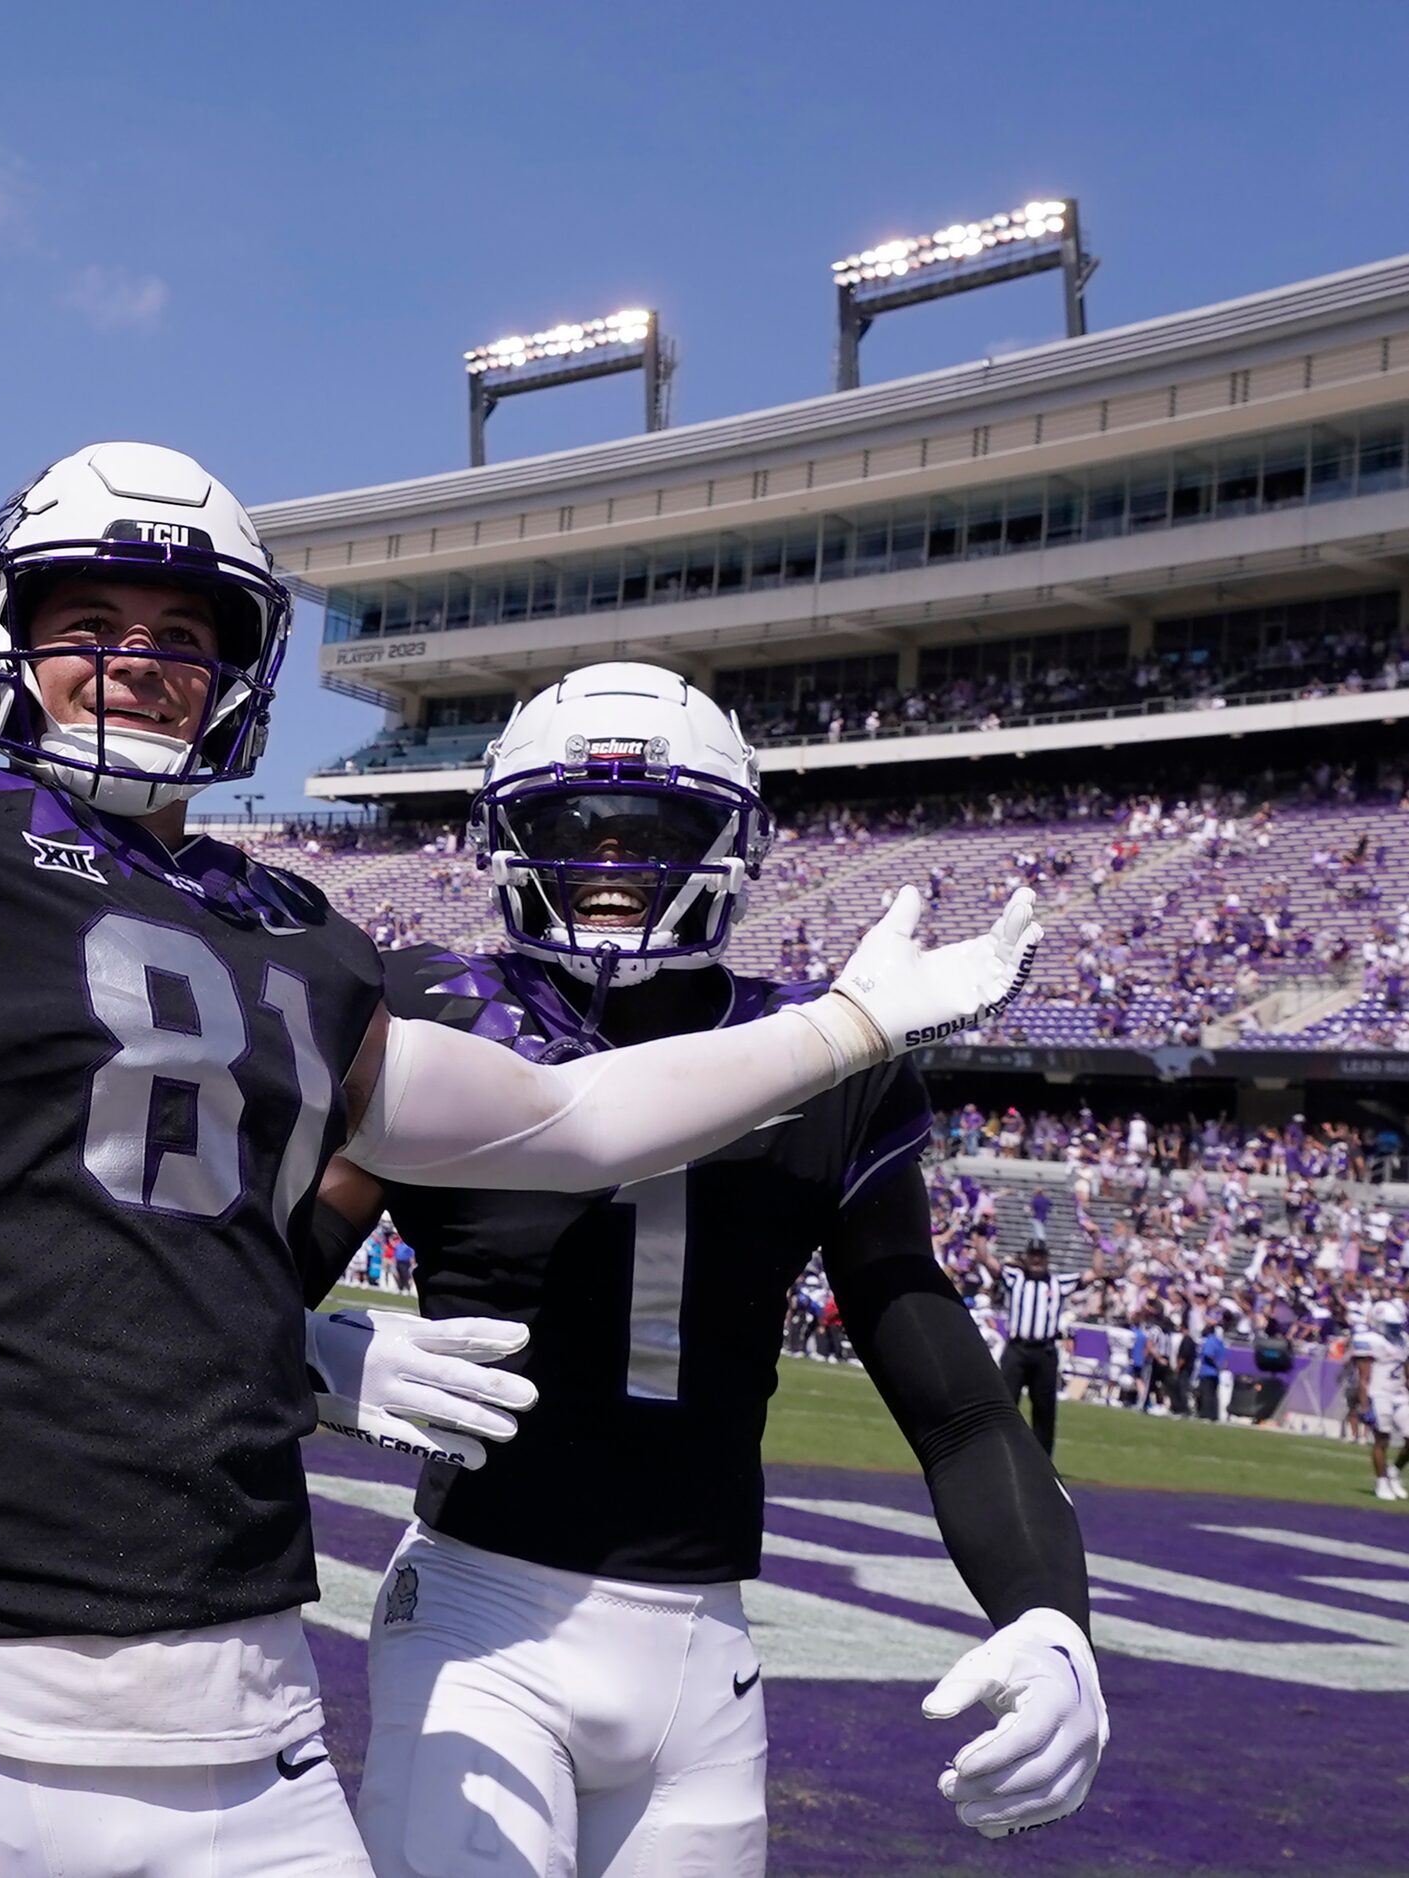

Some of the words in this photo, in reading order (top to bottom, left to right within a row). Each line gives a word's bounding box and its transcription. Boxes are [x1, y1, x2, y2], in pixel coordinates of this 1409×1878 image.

[136, 522, 189, 547] TCU
[388, 641, 427, 658] 2023
[590, 738, 644, 755] schutt
[80, 912, 333, 1248] 81
[611, 1163, 688, 1400] 1
